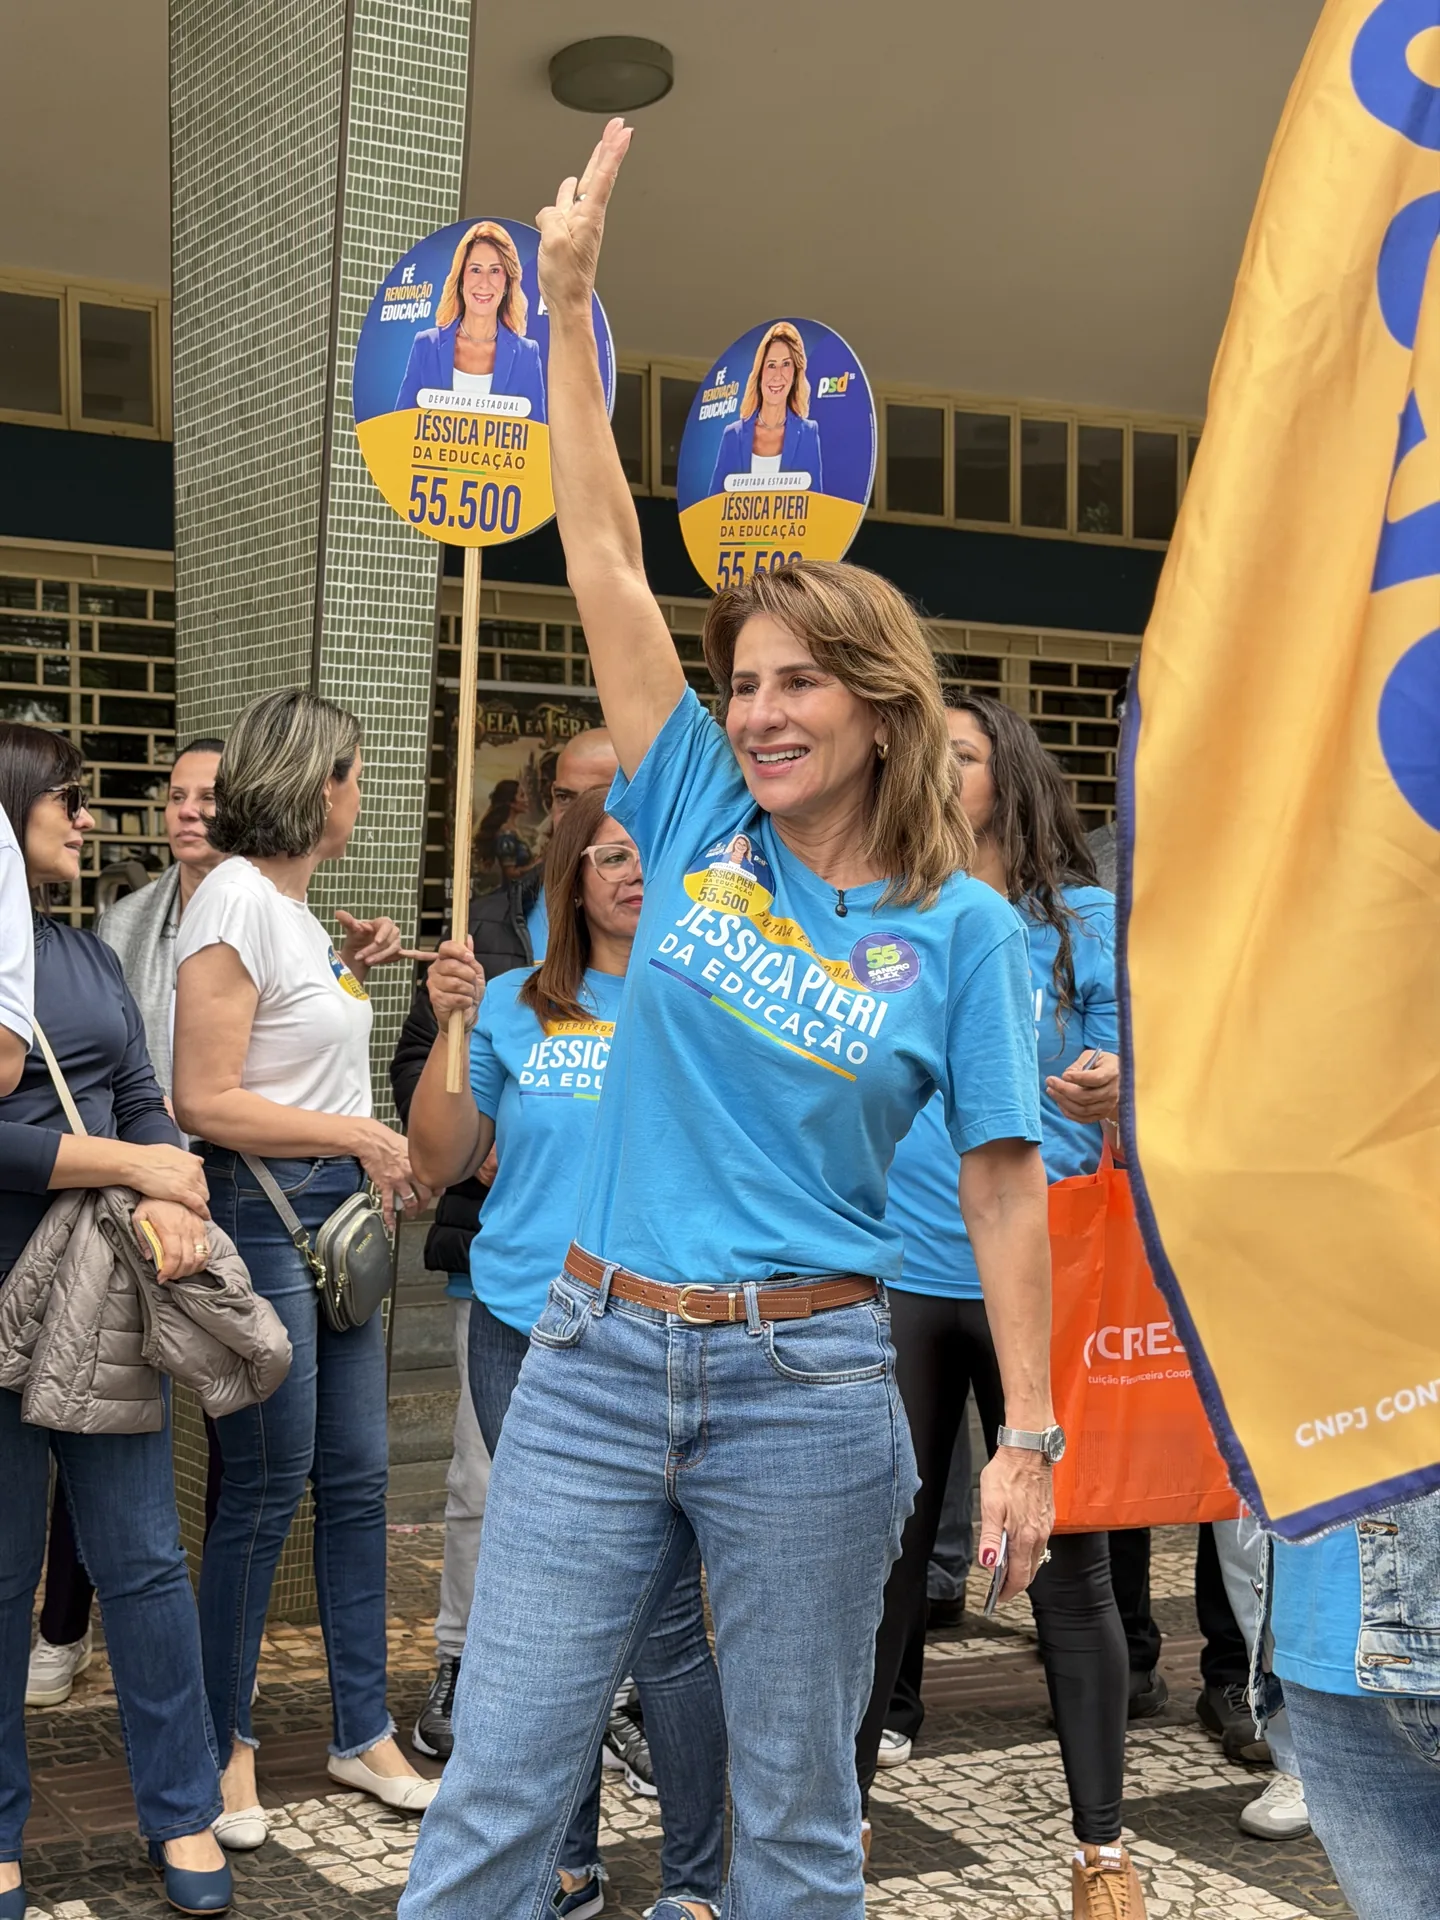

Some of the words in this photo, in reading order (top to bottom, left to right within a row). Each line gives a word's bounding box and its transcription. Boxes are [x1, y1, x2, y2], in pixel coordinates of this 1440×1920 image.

[401, 263, 416, 284] FÉ
[384, 281, 433, 302] RENOVAÇÃO
[380, 299, 431, 323] EDUCAÇÃO
[715, 366, 727, 386] FÉ
[817, 371, 849, 398] psd
[428, 394, 472, 407] DEPUTADA
[475, 399, 519, 411] ESTADUAL
[702, 381, 739, 404] RENOVAÇÃO
[699, 396, 737, 421] EDUCAÇÃO
[414, 410, 479, 446] JÉSSICA
[483, 420, 529, 451] PIERI
[413, 446, 432, 460] DA
[439, 448, 525, 470] EDUCAÇÃO
[732, 478, 765, 487] DEPUTADA
[768, 477, 802, 486] ESTADUAL
[408, 474, 522, 535] 55.500
[721, 492, 769, 520] JÉSSICA
[773, 495, 809, 520] PIERI
[720, 526, 735, 537] DA
[739, 522, 806, 539] EDUCAÇÃO
[736, 875, 756, 891] PIERI
[697, 886, 749, 914] 55.500
[866, 944, 900, 969] 55
[868, 963, 910, 977] SANDRO
[658, 933, 695, 966] DA
[701, 958, 868, 1065] EDUCAÇÃO
[797, 963, 889, 1038] PIERI
[519, 1070, 550, 1088] DA
[1165, 1369, 1193, 1379] Coop
[1295, 1406, 1369, 1448] CNPJ
[1375, 1377, 1440, 1422] CON
